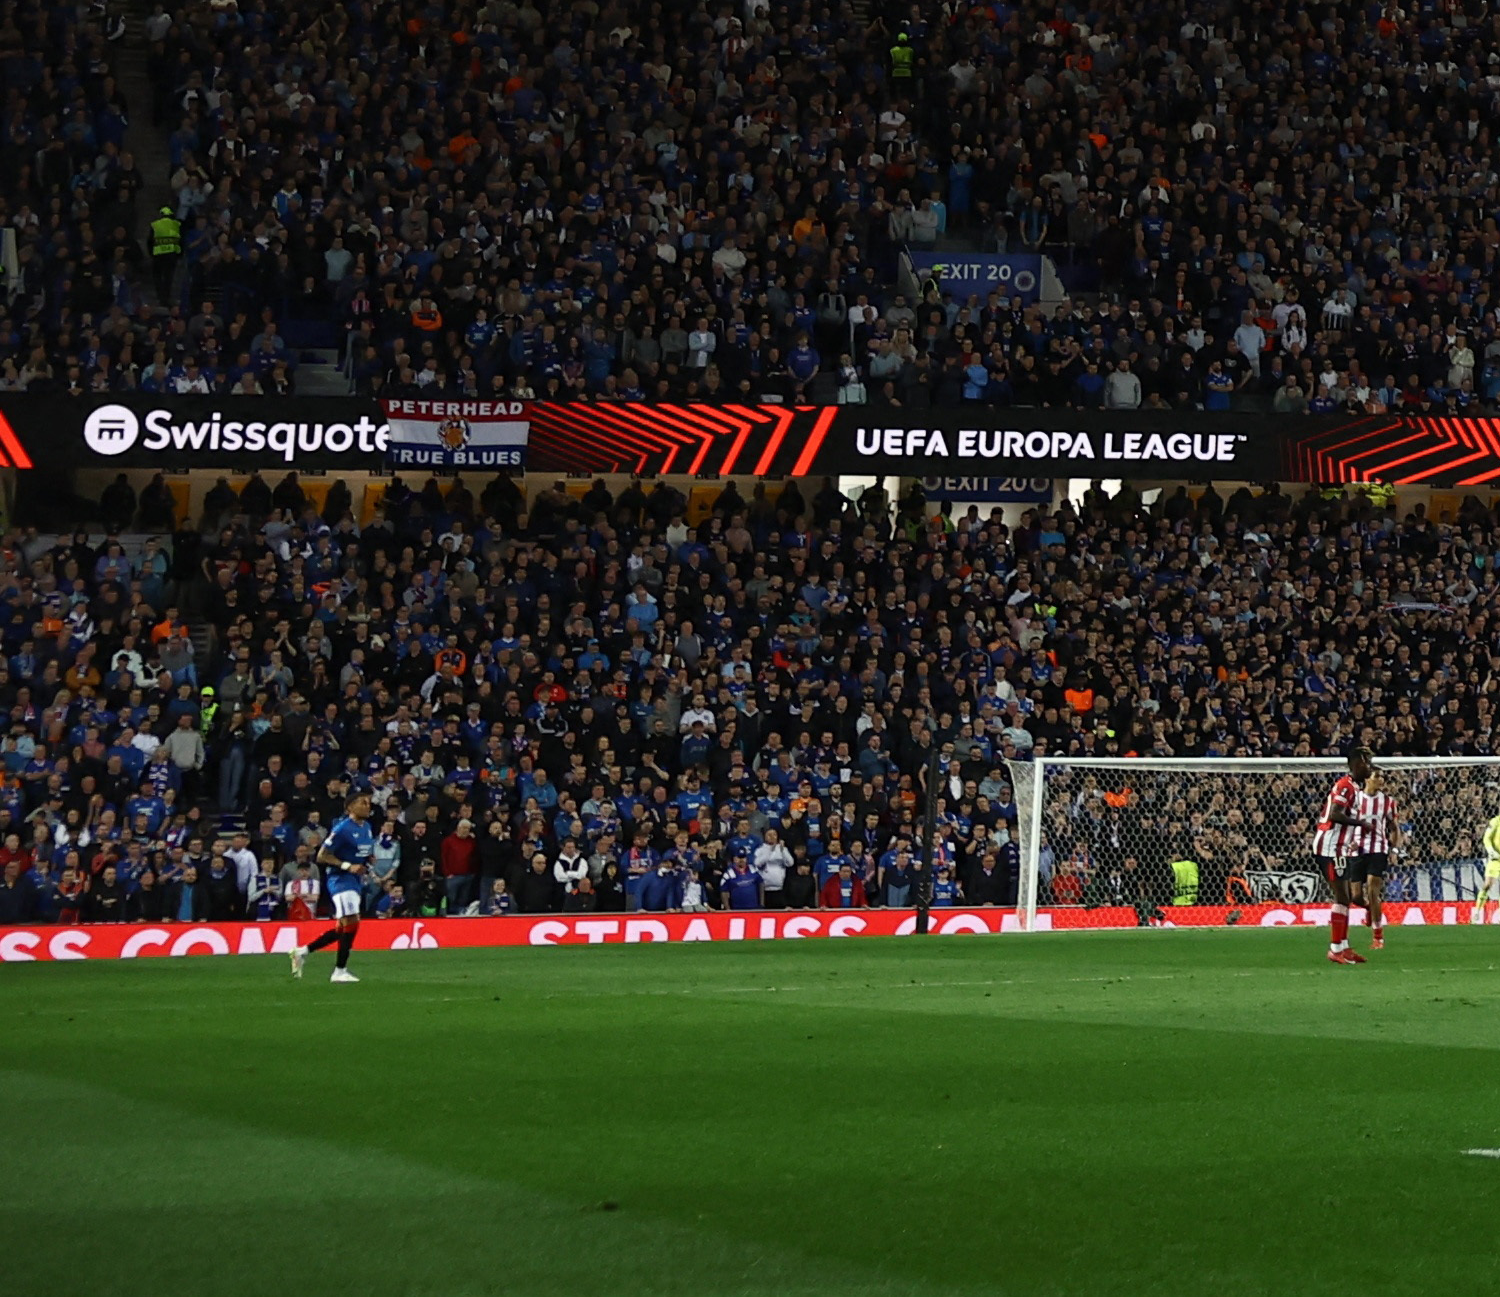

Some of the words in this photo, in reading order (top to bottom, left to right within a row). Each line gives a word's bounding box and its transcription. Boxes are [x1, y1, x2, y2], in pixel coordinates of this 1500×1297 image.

[940, 263, 981, 280] EXIT
[987, 264, 1011, 281] 20
[388, 400, 524, 416] PETERHEAD
[142, 409, 393, 462] Swissquote
[855, 427, 949, 458] UEFA
[957, 429, 1095, 460] EUROPA
[392, 449, 444, 464] TRUE
[454, 451, 522, 465] BLUES
[1333, 856, 1347, 869] 10
